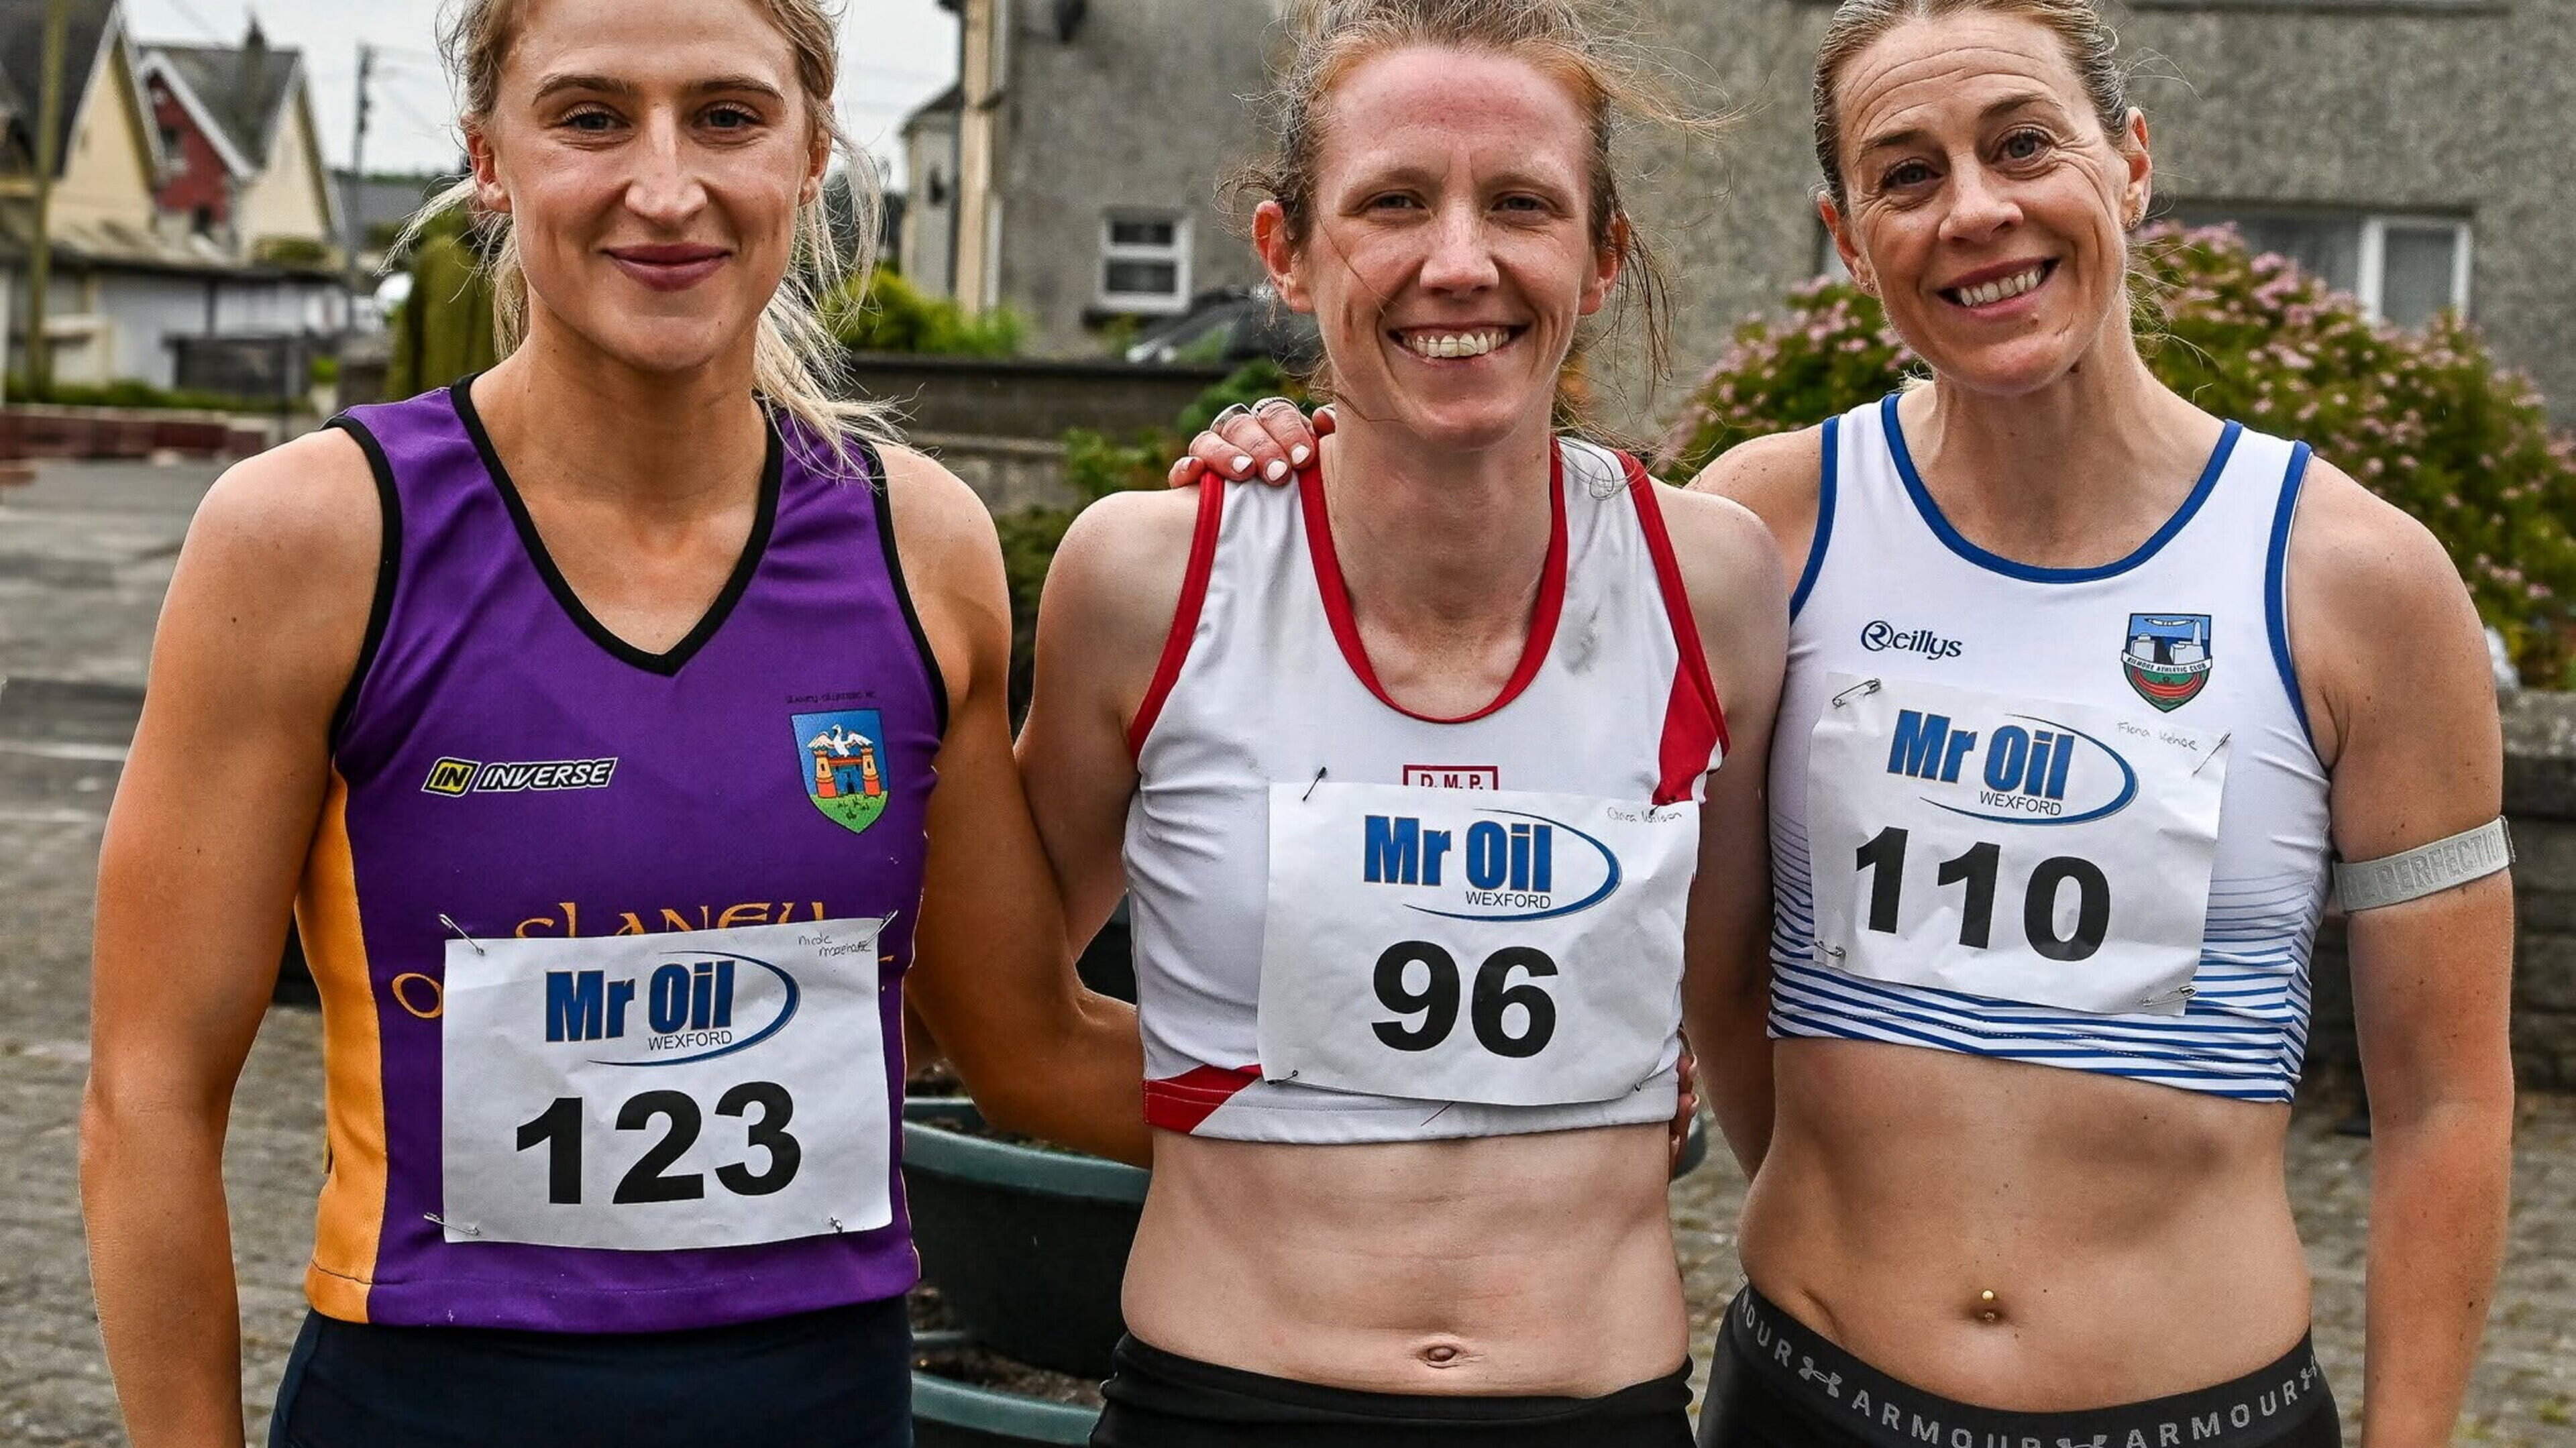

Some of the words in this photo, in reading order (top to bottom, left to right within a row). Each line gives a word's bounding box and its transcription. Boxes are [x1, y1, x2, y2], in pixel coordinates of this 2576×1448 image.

[1860, 620, 1963, 661] Reillys
[482, 763, 610, 787] INVERSE
[1886, 708, 1978, 784] Mr
[1982, 724, 2076, 801] Oil
[1978, 789, 2062, 816] WEXFORD
[1364, 814, 1452, 887] Mr
[1466, 820, 1553, 893] Oil
[2375, 828, 2502, 898] PERFECTIO
[1465, 891, 1552, 909] WEXFORD
[1856, 825, 2111, 962] 110
[545, 969, 635, 1042] Mr
[648, 959, 735, 1034] Oil
[1371, 940, 1559, 1058] 96
[647, 1030, 733, 1052] WEXFORD
[516, 1080, 802, 1205] 123
[2126, 1380, 2294, 1448] ARMOUR
